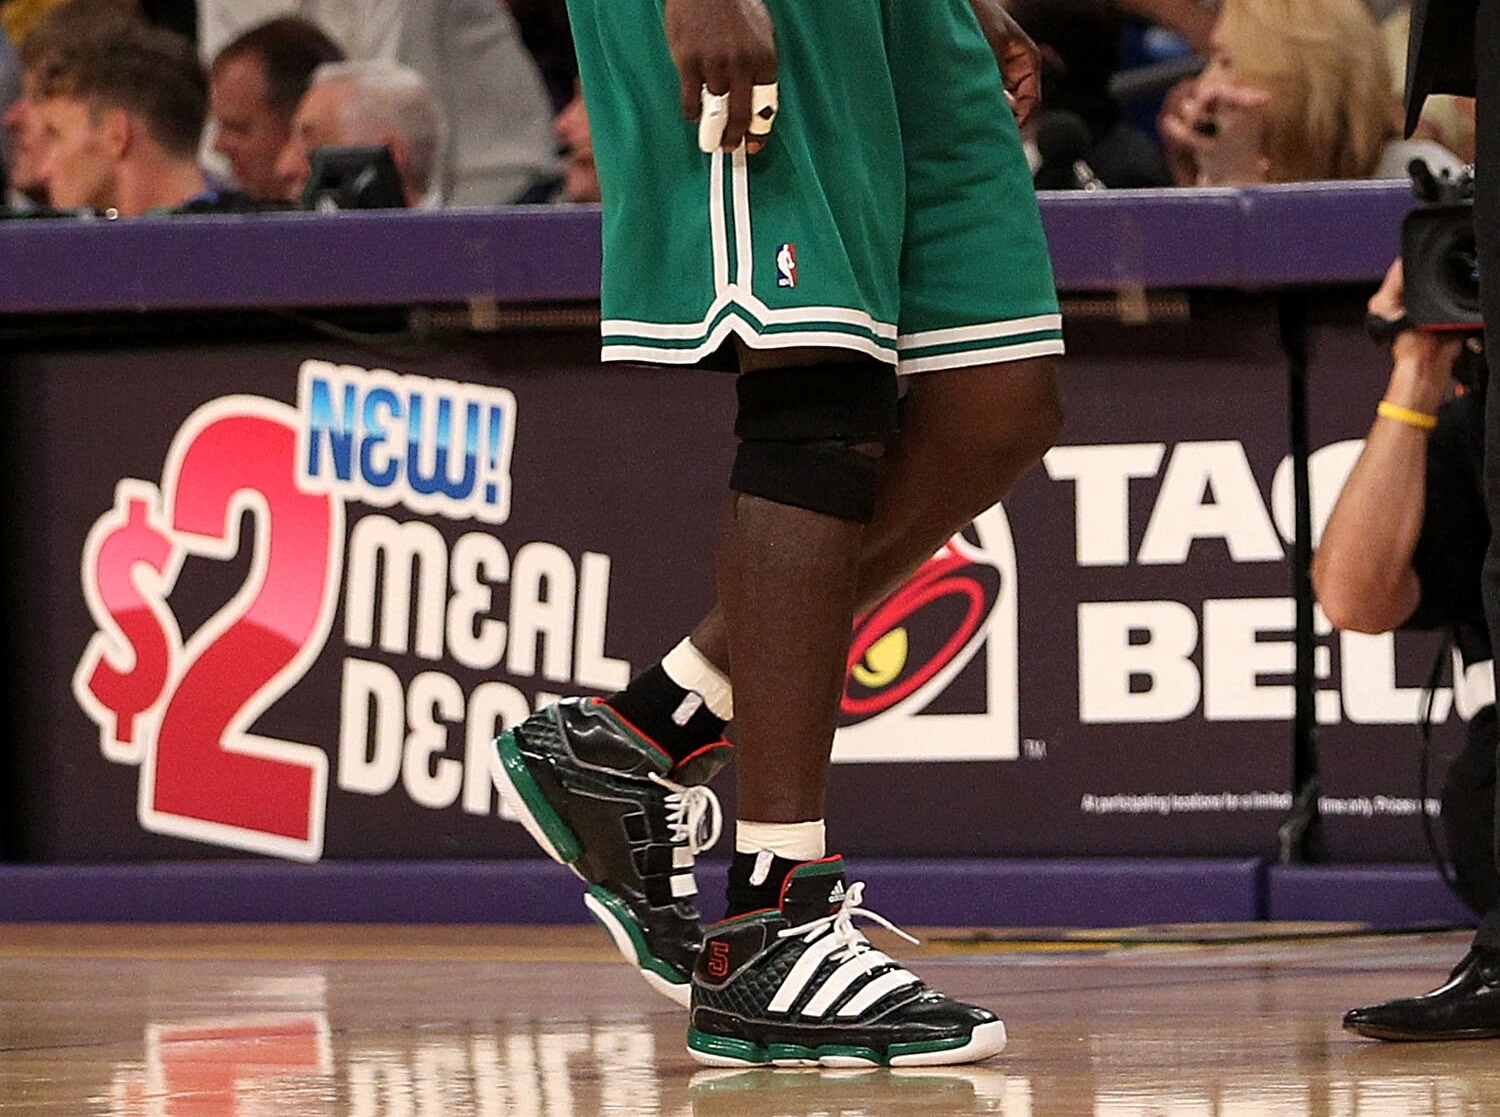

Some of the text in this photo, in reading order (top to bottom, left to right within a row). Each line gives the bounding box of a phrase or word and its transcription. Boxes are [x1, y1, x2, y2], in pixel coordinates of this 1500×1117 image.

[304, 370, 508, 514] NEW!
[76, 397, 341, 860] $2
[344, 514, 632, 691] MEAL
[708, 940, 729, 977] 5
